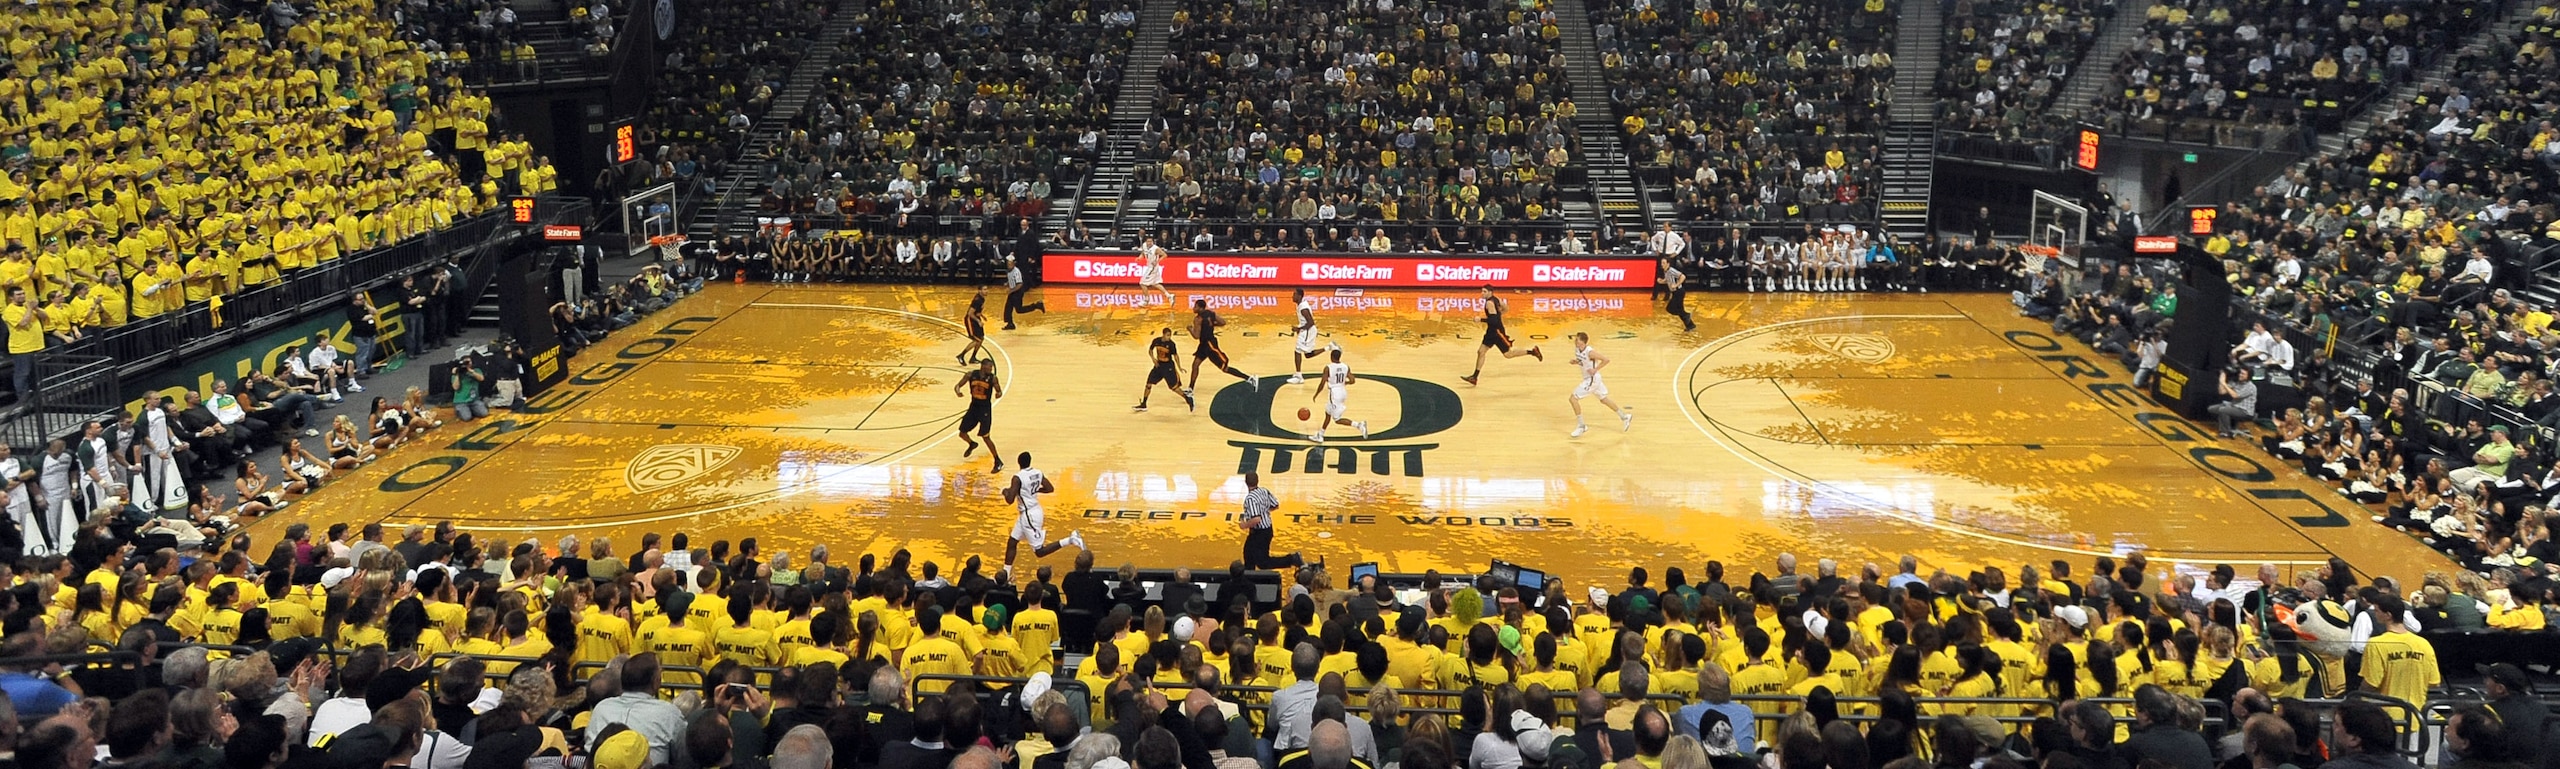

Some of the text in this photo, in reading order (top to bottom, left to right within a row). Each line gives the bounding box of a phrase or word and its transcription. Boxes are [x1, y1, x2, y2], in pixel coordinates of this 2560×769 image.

[617, 138, 633, 162] 33
[515, 208, 530, 222] 33
[1335, 373, 1345, 384] 10
[1030, 480, 1041, 495] 22
[1082, 509, 1207, 521] DEEP
[1284, 513, 1377, 525] THE
[1396, 515, 1574, 527] WOODS
[695, 609, 711, 618] MATT
[1018, 622, 1051, 632] MAC MATT
[1584, 625, 1599, 634] MAC
[596, 629, 613, 641] MATT
[779, 635, 795, 644] MAC
[941, 629, 957, 640] MATT
[654, 643, 693, 653] MAC MATT
[717, 642, 755, 656] MAC MATT
[910, 653, 948, 665] MAC MATT
[991, 649, 1009, 659] MATT
[2387, 650, 2425, 662] MAC MATT
[1264, 664, 1285, 676] MATT
[1453, 672, 1472, 685] MAC
[1763, 683, 1783, 692] MATT
[1091, 695, 1102, 705] AC
